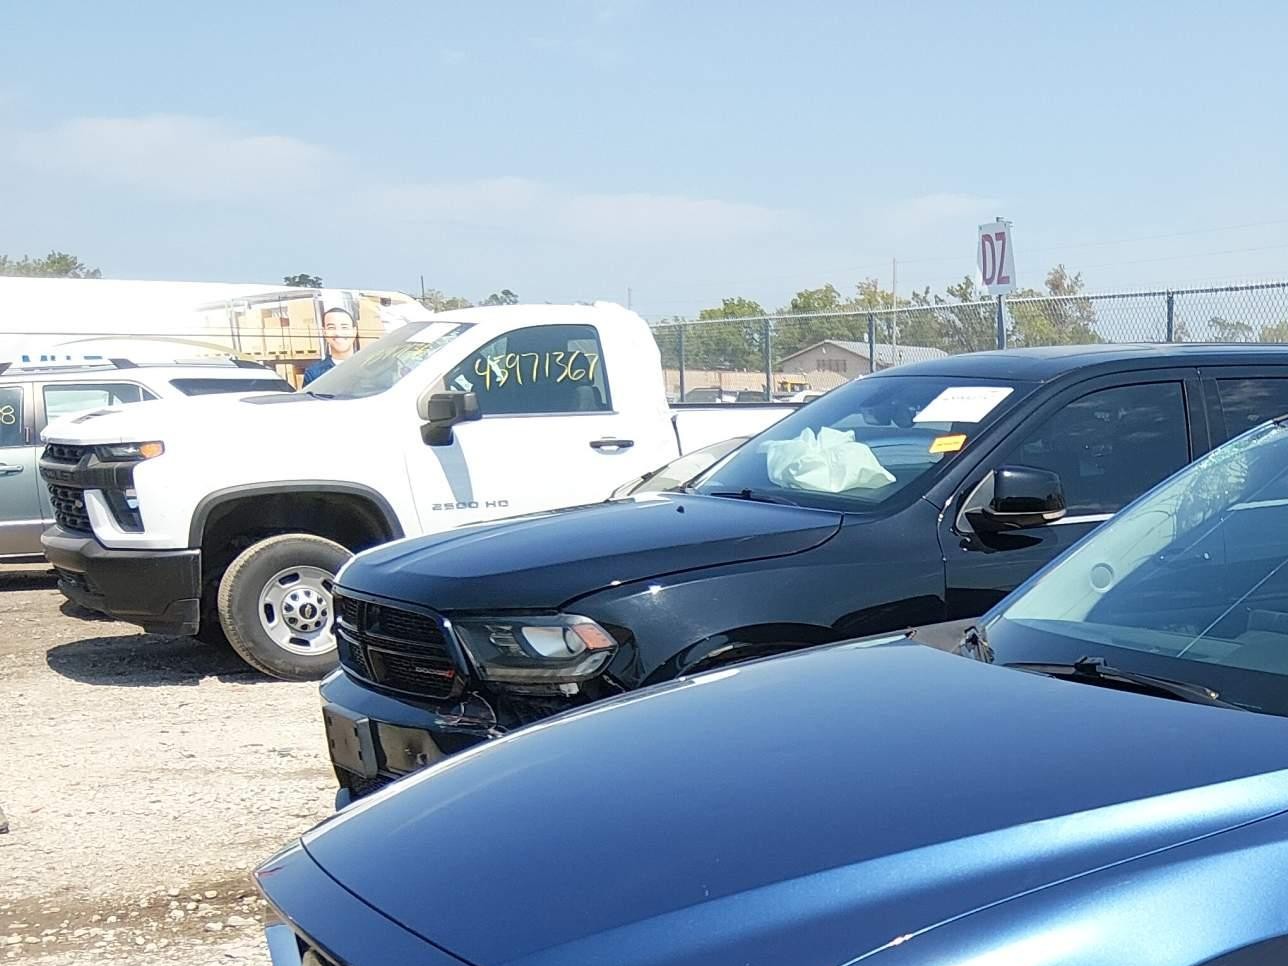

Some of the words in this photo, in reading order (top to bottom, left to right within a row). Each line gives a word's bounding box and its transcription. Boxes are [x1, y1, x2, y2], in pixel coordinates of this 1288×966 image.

[474, 350, 600, 392] 45971367
[431, 501, 480, 511] 2500
[485, 500, 509, 508] HD
